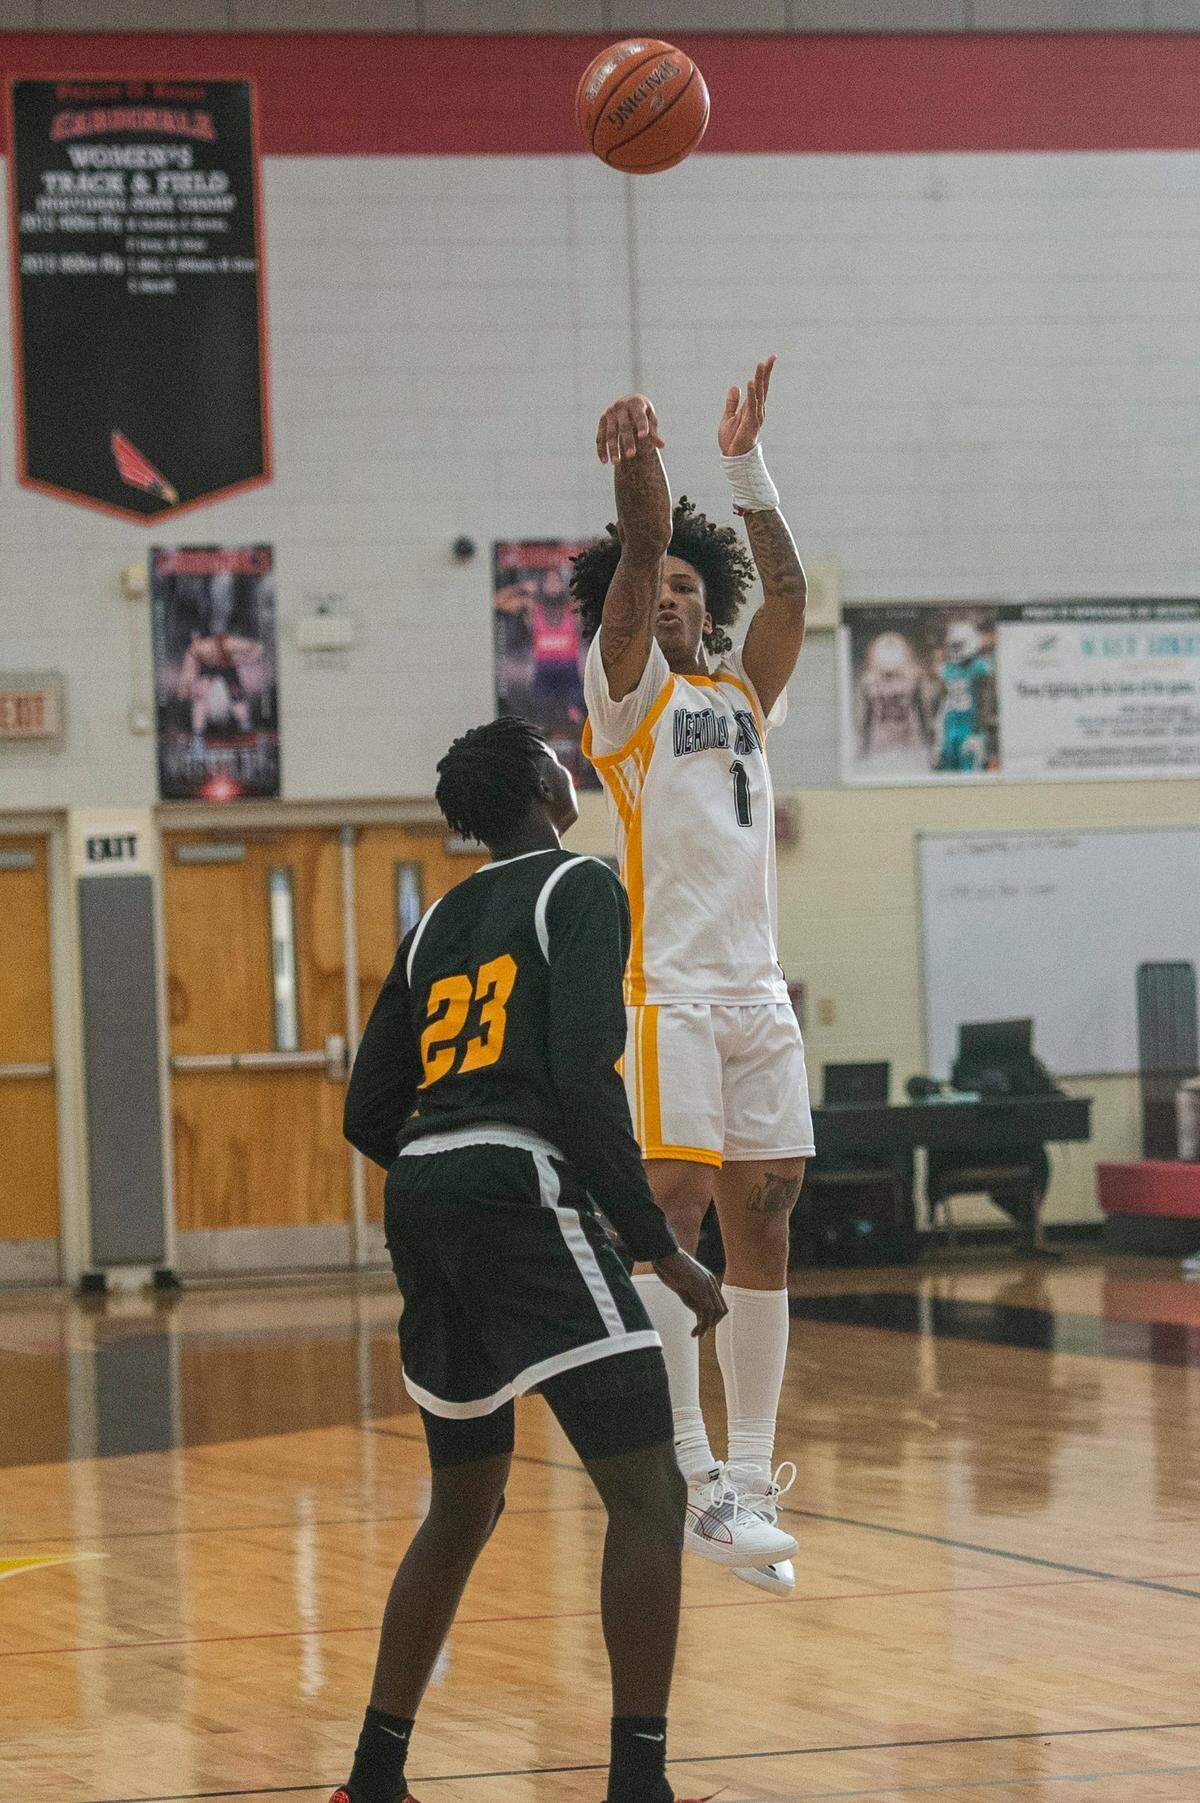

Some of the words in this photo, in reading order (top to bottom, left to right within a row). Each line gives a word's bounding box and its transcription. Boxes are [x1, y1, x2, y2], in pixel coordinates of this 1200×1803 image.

[607, 58, 681, 131] SPALDING
[68, 144, 194, 168] WOMEN'S
[41, 171, 126, 194] TRACK
[131, 171, 152, 194] &
[156, 170, 231, 193] FIELD
[729, 759, 753, 828] 1
[85, 834, 137, 862] EXIT
[416, 953, 518, 1090] 23
